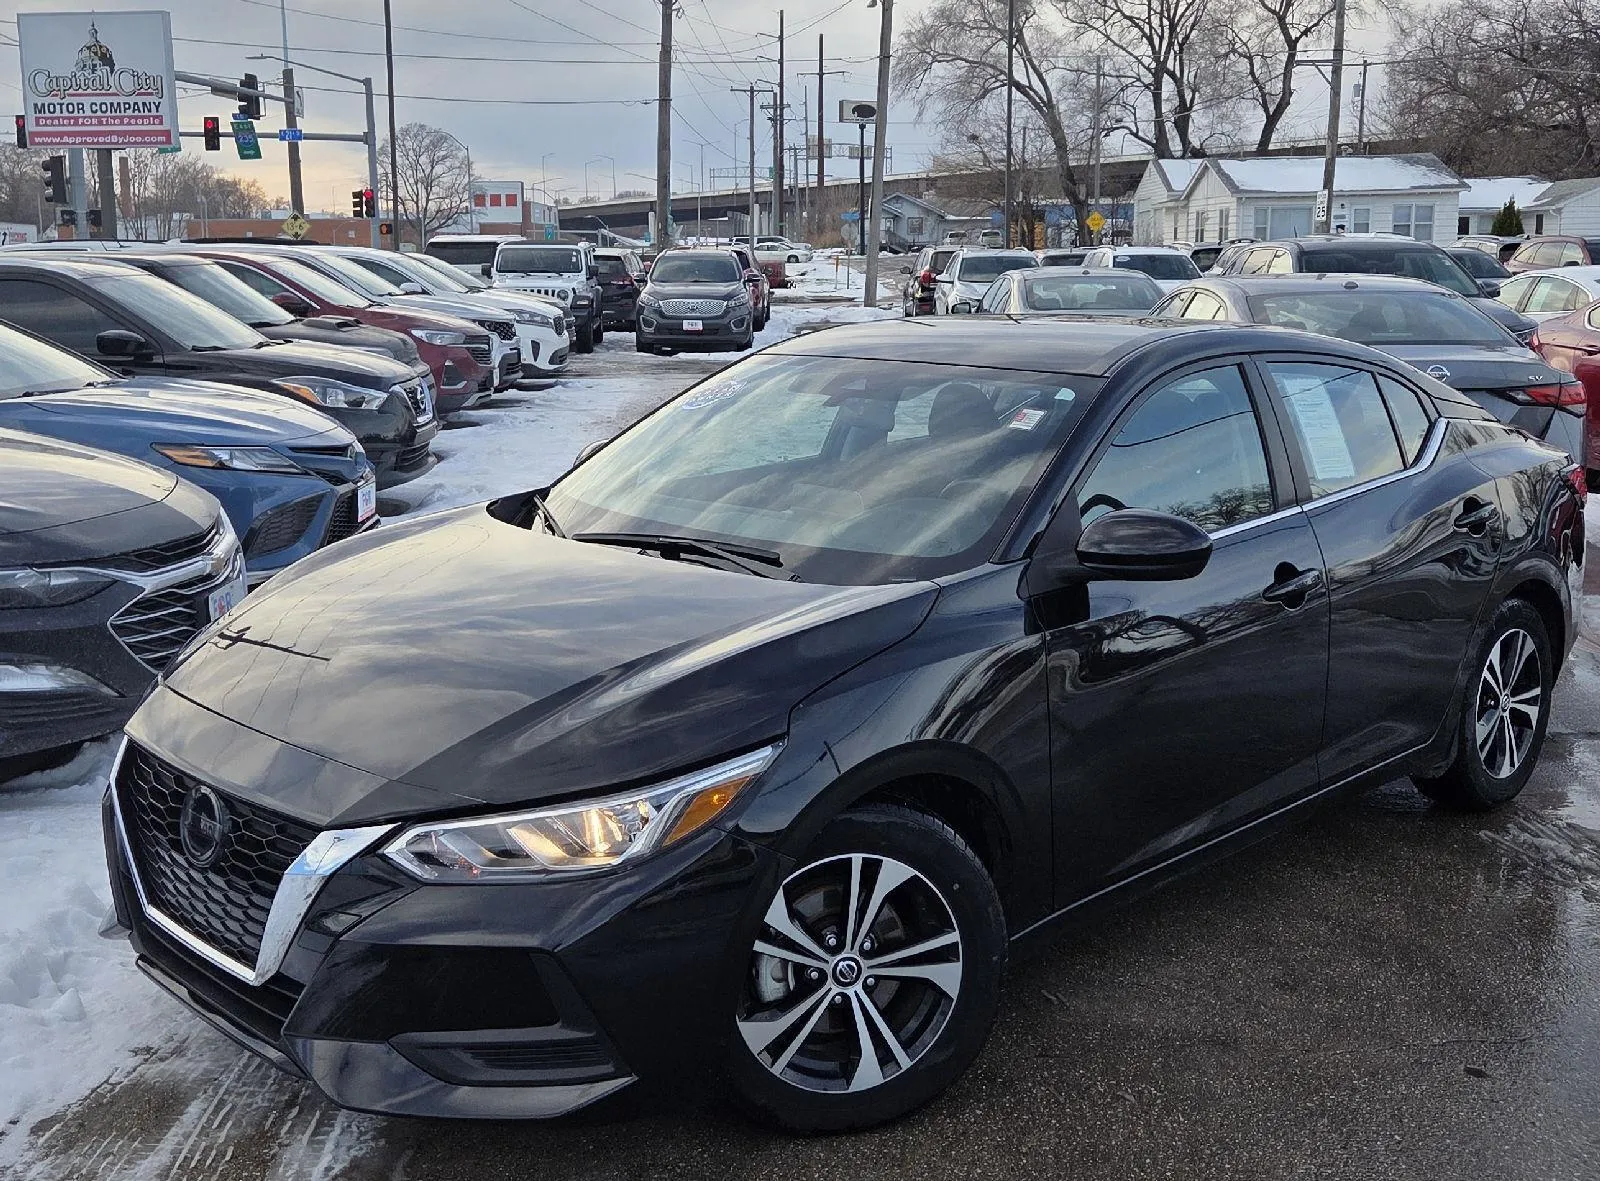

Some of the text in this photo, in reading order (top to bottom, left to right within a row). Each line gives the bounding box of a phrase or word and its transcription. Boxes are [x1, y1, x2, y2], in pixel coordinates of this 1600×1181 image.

[28, 67, 164, 100] Capital City
[33, 101, 162, 115] MOTOR COMPANY
[39, 117, 160, 126] Dealer FOR The People
[34, 134, 167, 144] www.ApprovedByJoe.com
[1316, 206, 1326, 218] 25
